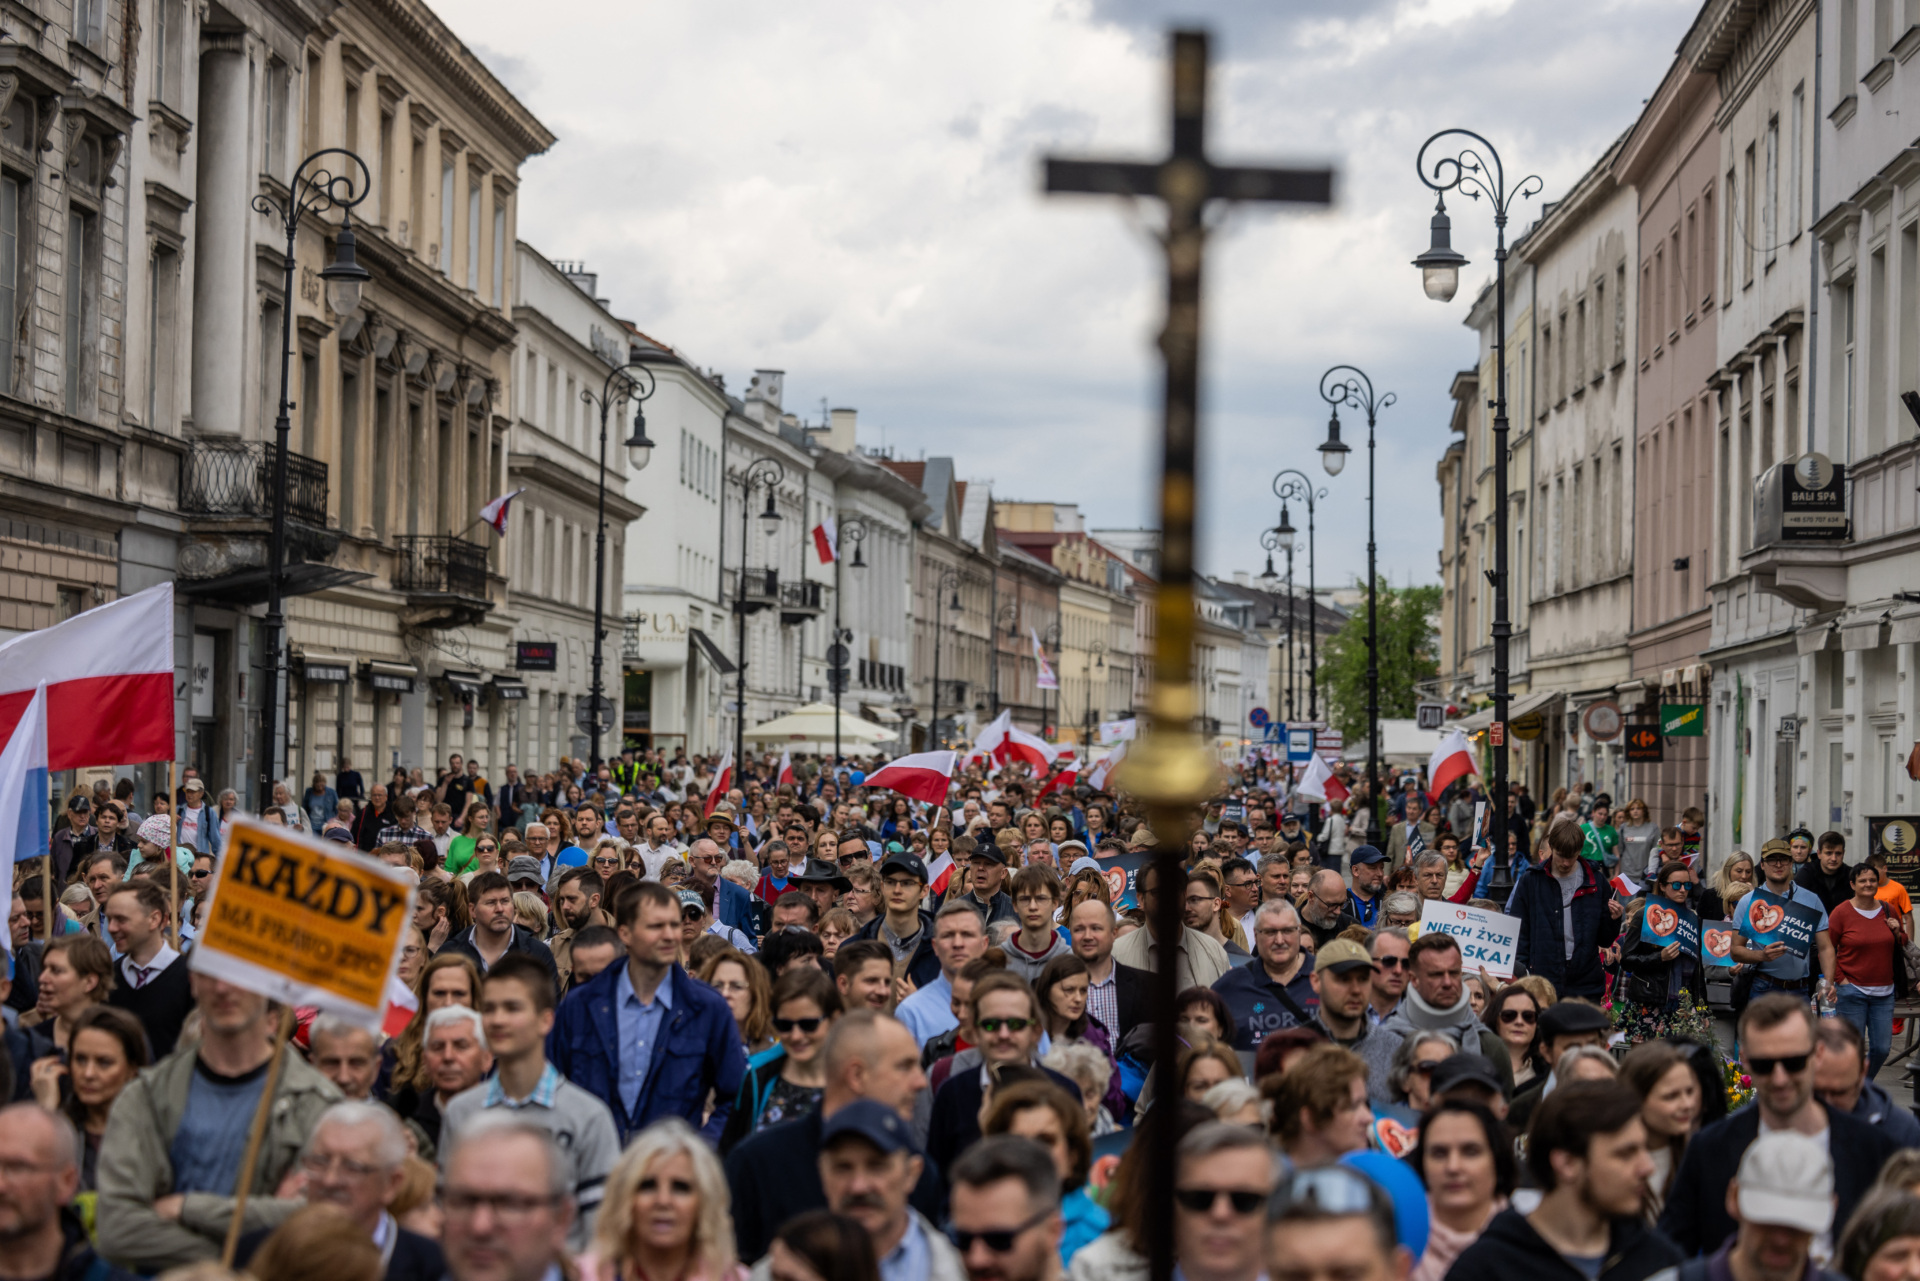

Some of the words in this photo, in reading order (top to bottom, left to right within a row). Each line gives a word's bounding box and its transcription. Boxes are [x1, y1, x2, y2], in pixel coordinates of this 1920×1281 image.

[1792, 492, 1814, 501] BALI
[1817, 492, 1836, 501] SPA
[1664, 708, 1700, 733] SUBWAY
[1784, 721, 1794, 731] 24
[229, 840, 406, 936] KAŻDY
[1426, 921, 1472, 937] NIECH
[1476, 926, 1513, 947] ŻYJE
[1678, 918, 1698, 935] #FALA
[1778, 922, 1810, 943] ŻYCIA
[1783, 915, 1813, 932] #FALA
[1676, 925, 1698, 946] ŻYCIA
[1462, 944, 1511, 966] SKA!
